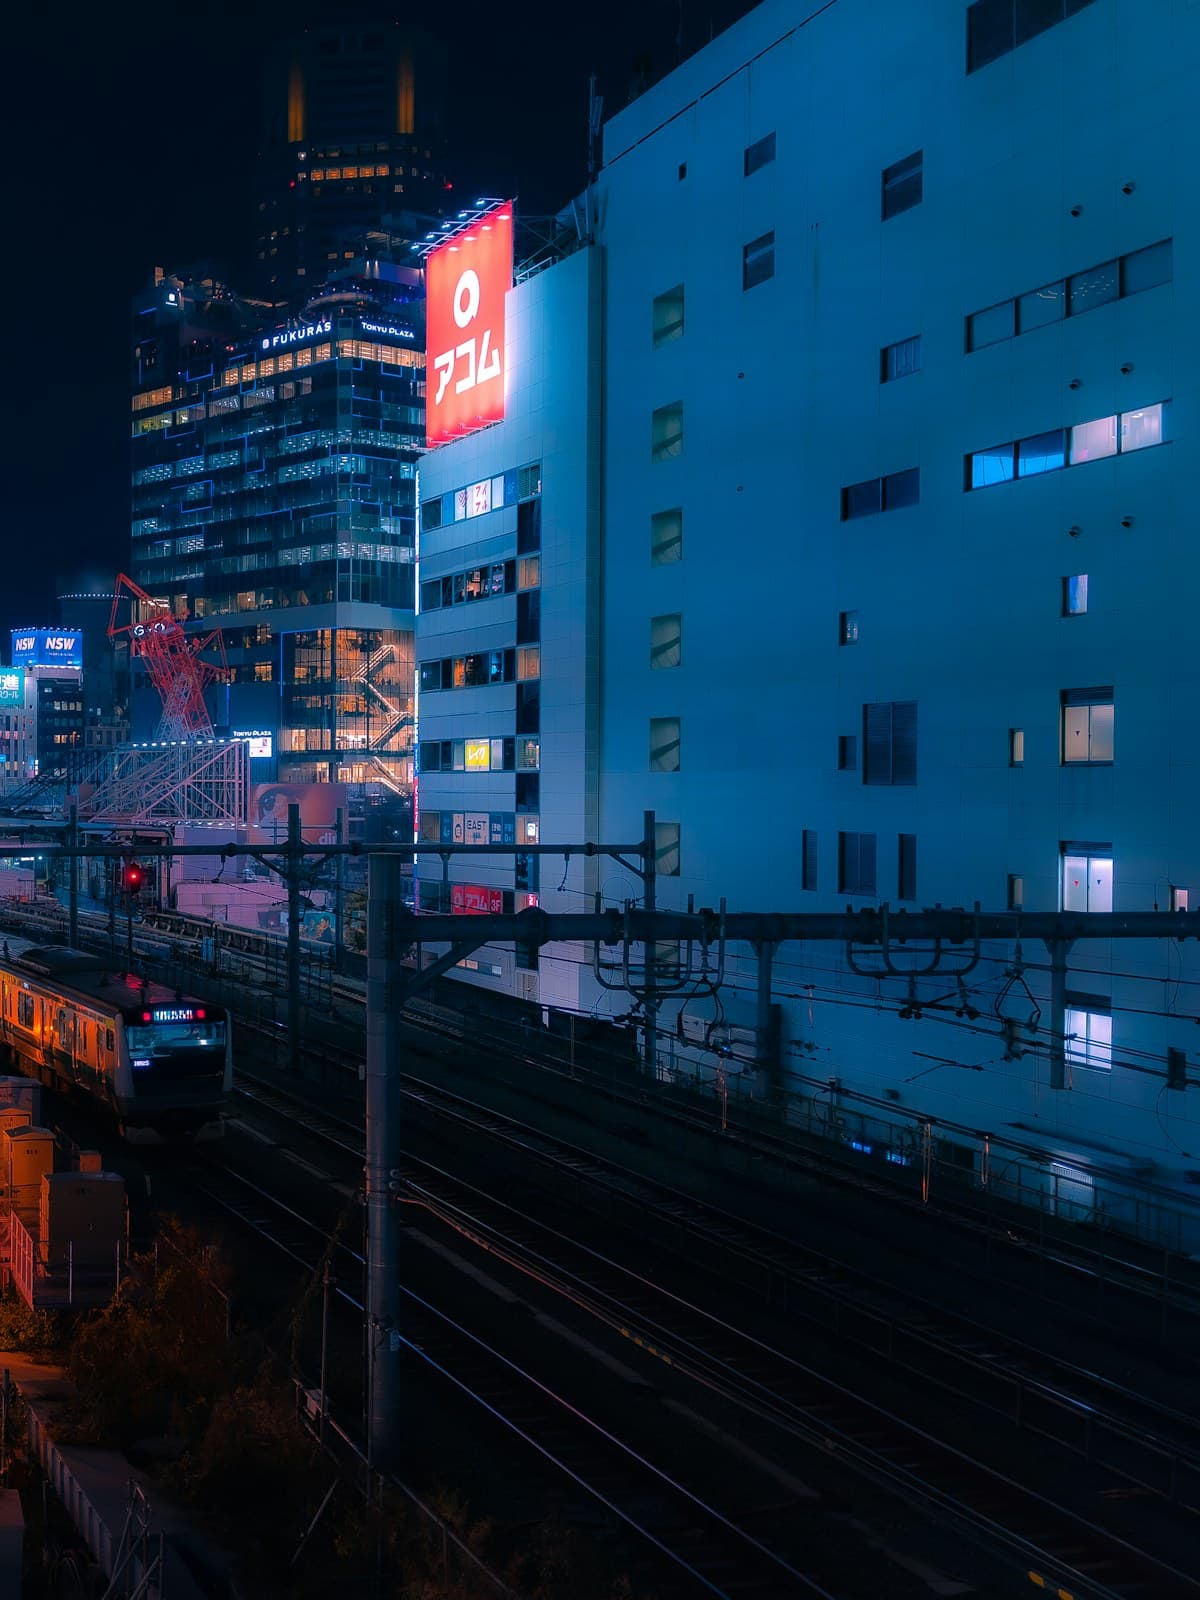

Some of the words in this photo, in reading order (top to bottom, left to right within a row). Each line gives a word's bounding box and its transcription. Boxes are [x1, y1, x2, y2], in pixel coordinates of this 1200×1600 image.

[272, 321, 332, 347] FUKURAS
[361, 321, 387, 333] TOKYU
[388, 327, 415, 339] PLAZA
[433, 329, 501, 406] アコム
[15, 636, 36, 651] NSW
[45, 636, 75, 650] NSW
[467, 746, 486, 761] レイク
[466, 820, 487, 831] EAST
[490, 899, 501, 912] 3F
